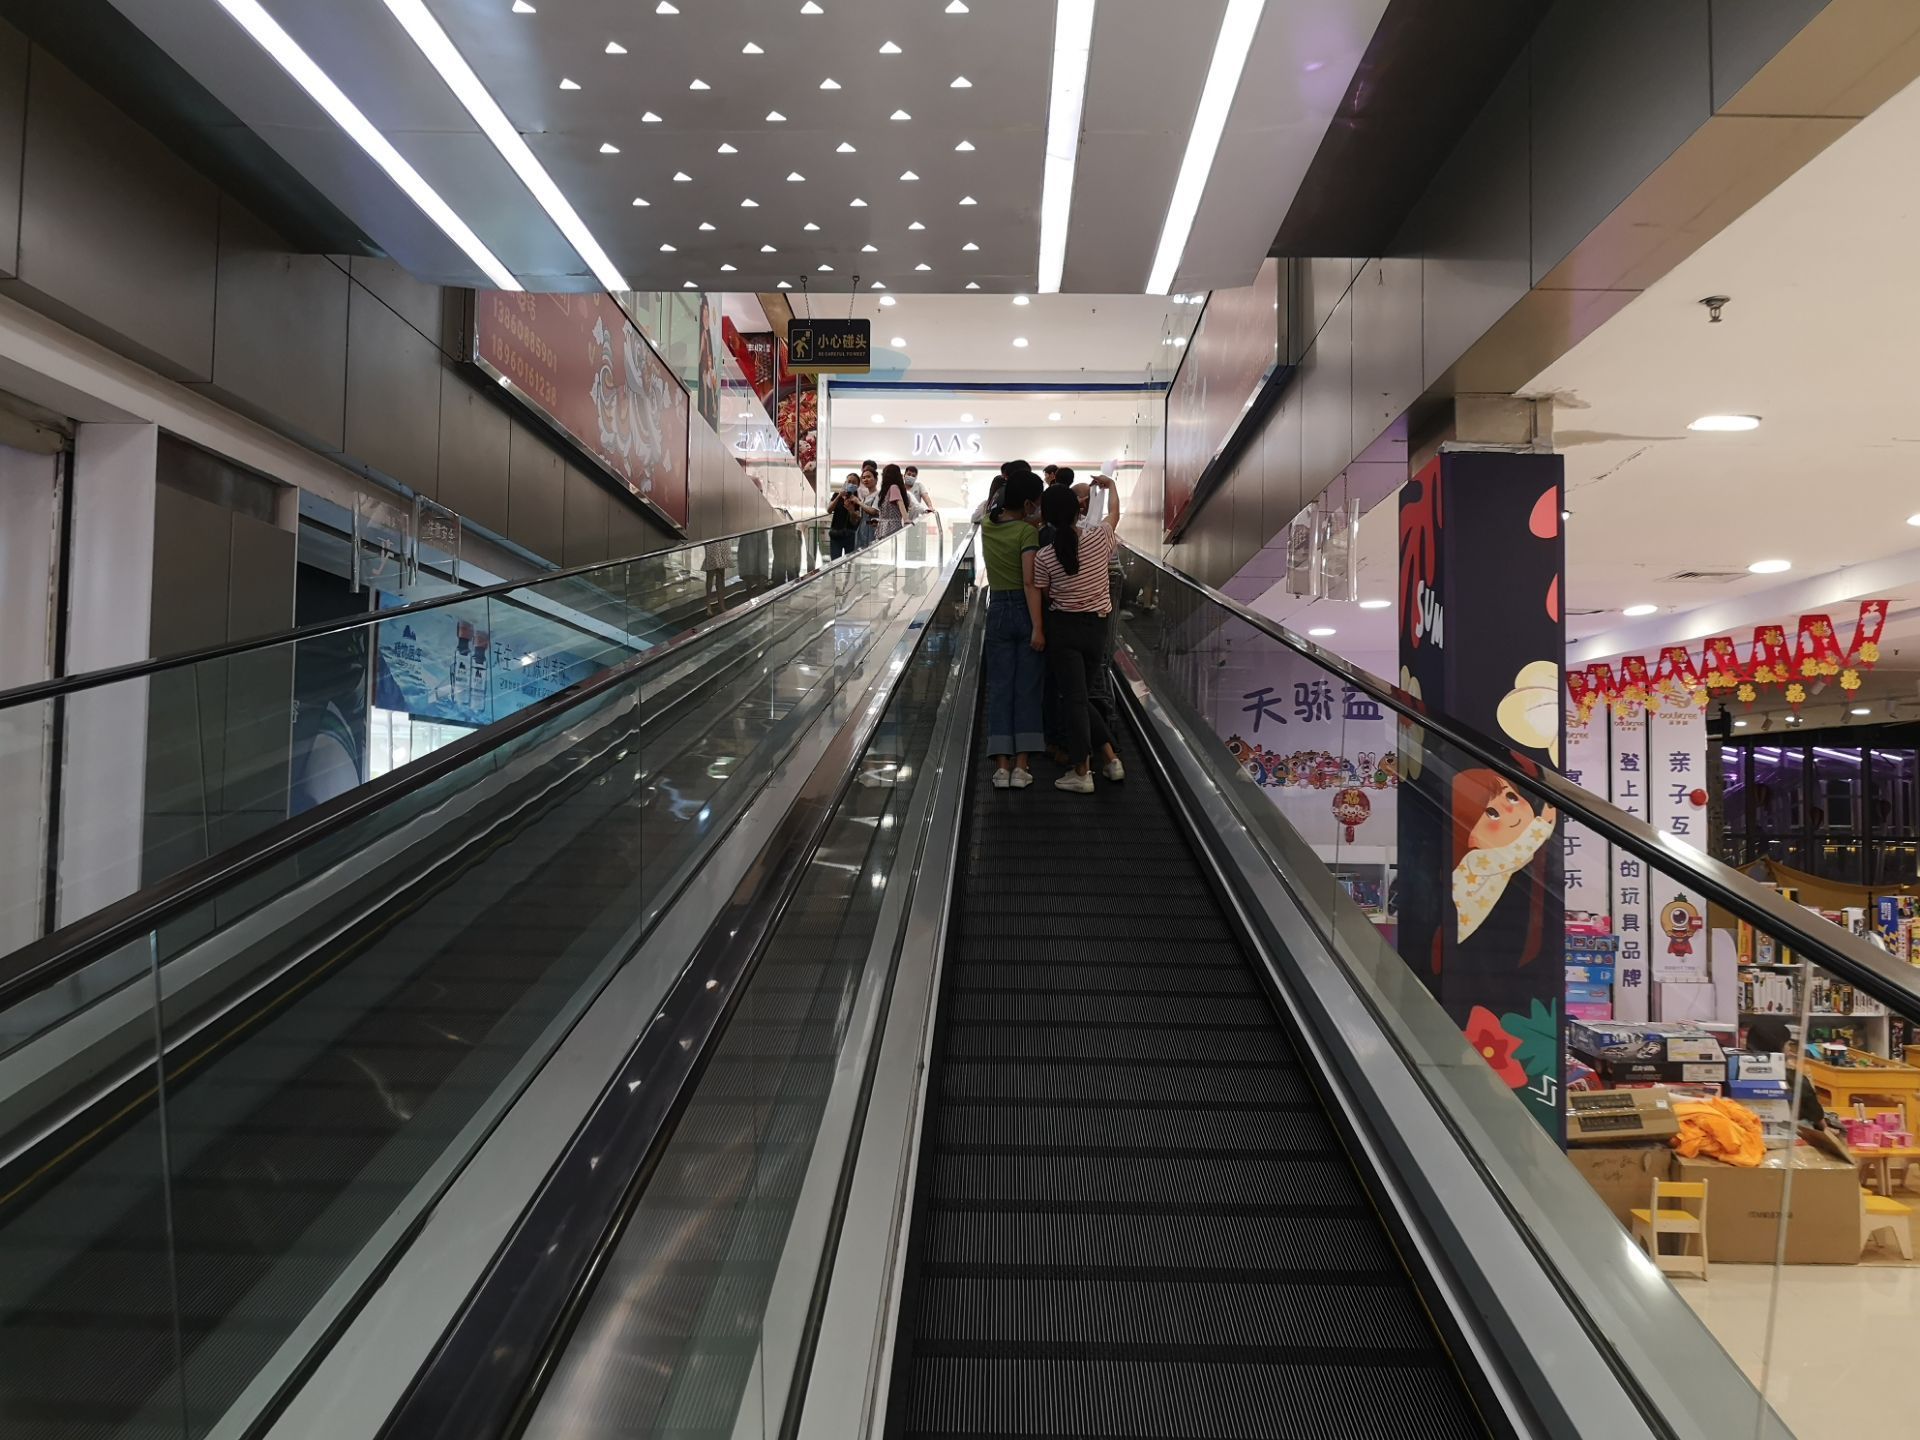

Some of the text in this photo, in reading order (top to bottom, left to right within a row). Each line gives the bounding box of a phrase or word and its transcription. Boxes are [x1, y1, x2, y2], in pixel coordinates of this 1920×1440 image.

[818, 333, 867, 349] 小心碰头
[912, 432, 983, 456] JAAS
[1415, 580, 1444, 650] SUM
[1242, 680, 1384, 733] 天骄益
